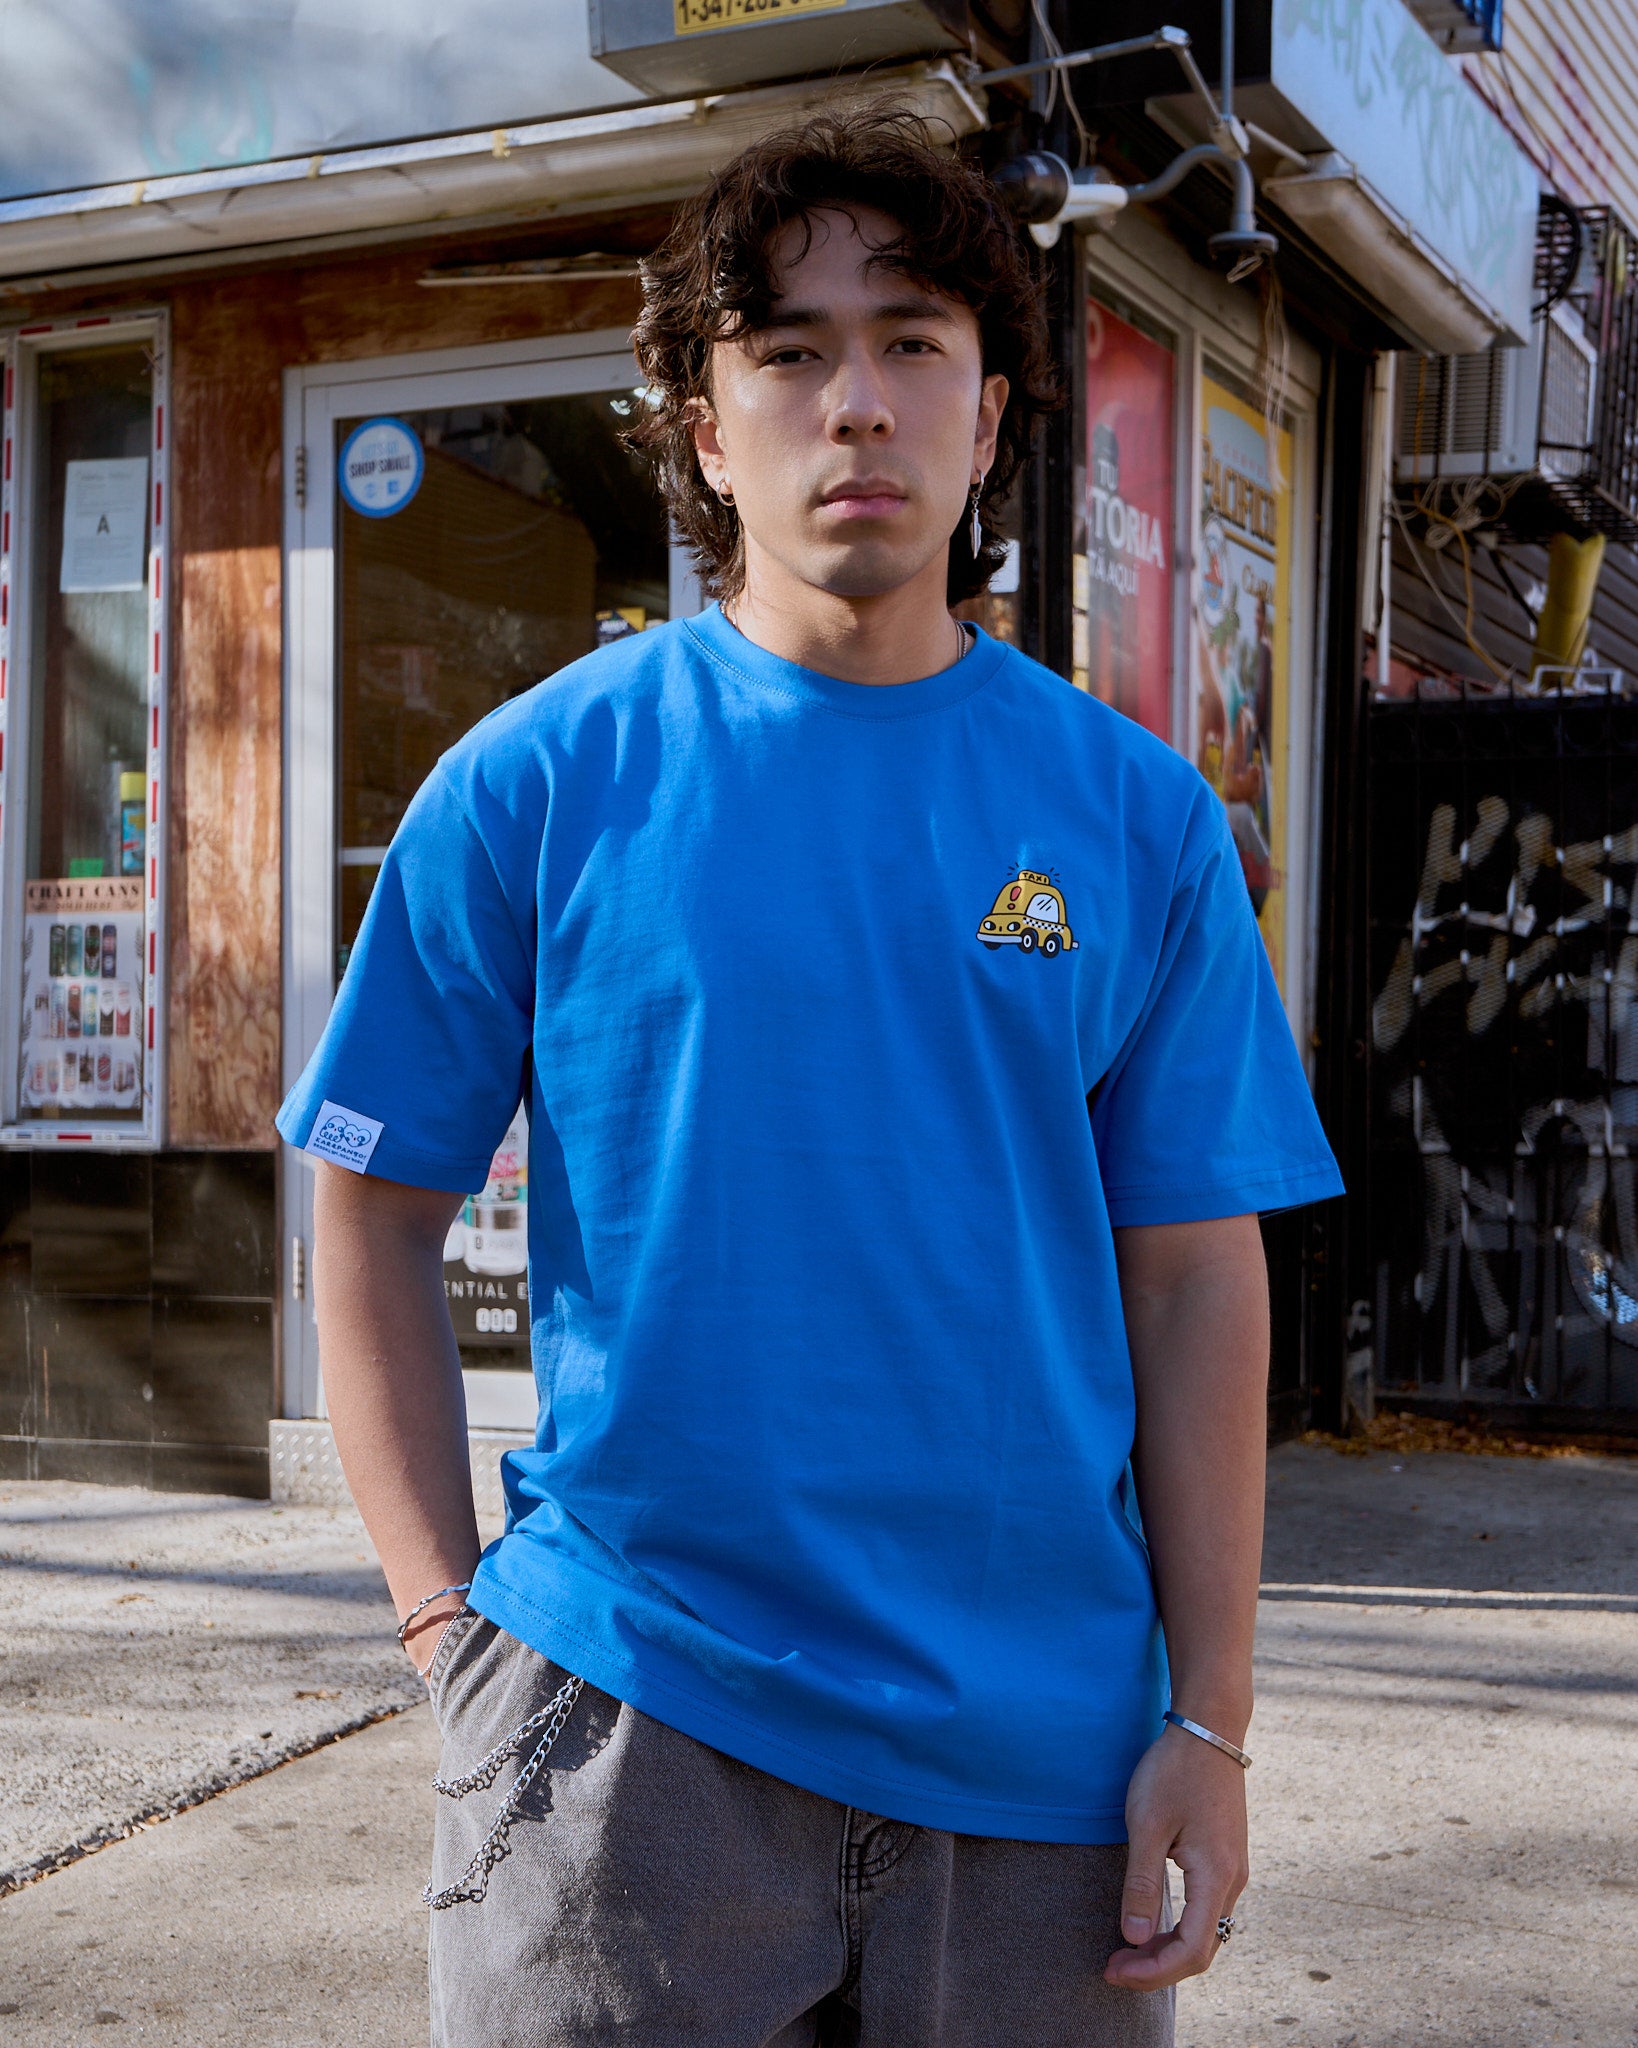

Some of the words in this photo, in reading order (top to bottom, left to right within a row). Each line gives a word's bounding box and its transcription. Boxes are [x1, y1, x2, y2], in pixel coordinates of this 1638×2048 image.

[96, 513, 110, 535] A
[1086, 486, 1165, 570] TORIA
[1022, 872, 1047, 883] TAXI
[28, 884, 85, 899] CRAFT
[94, 883, 139, 898] CANS
